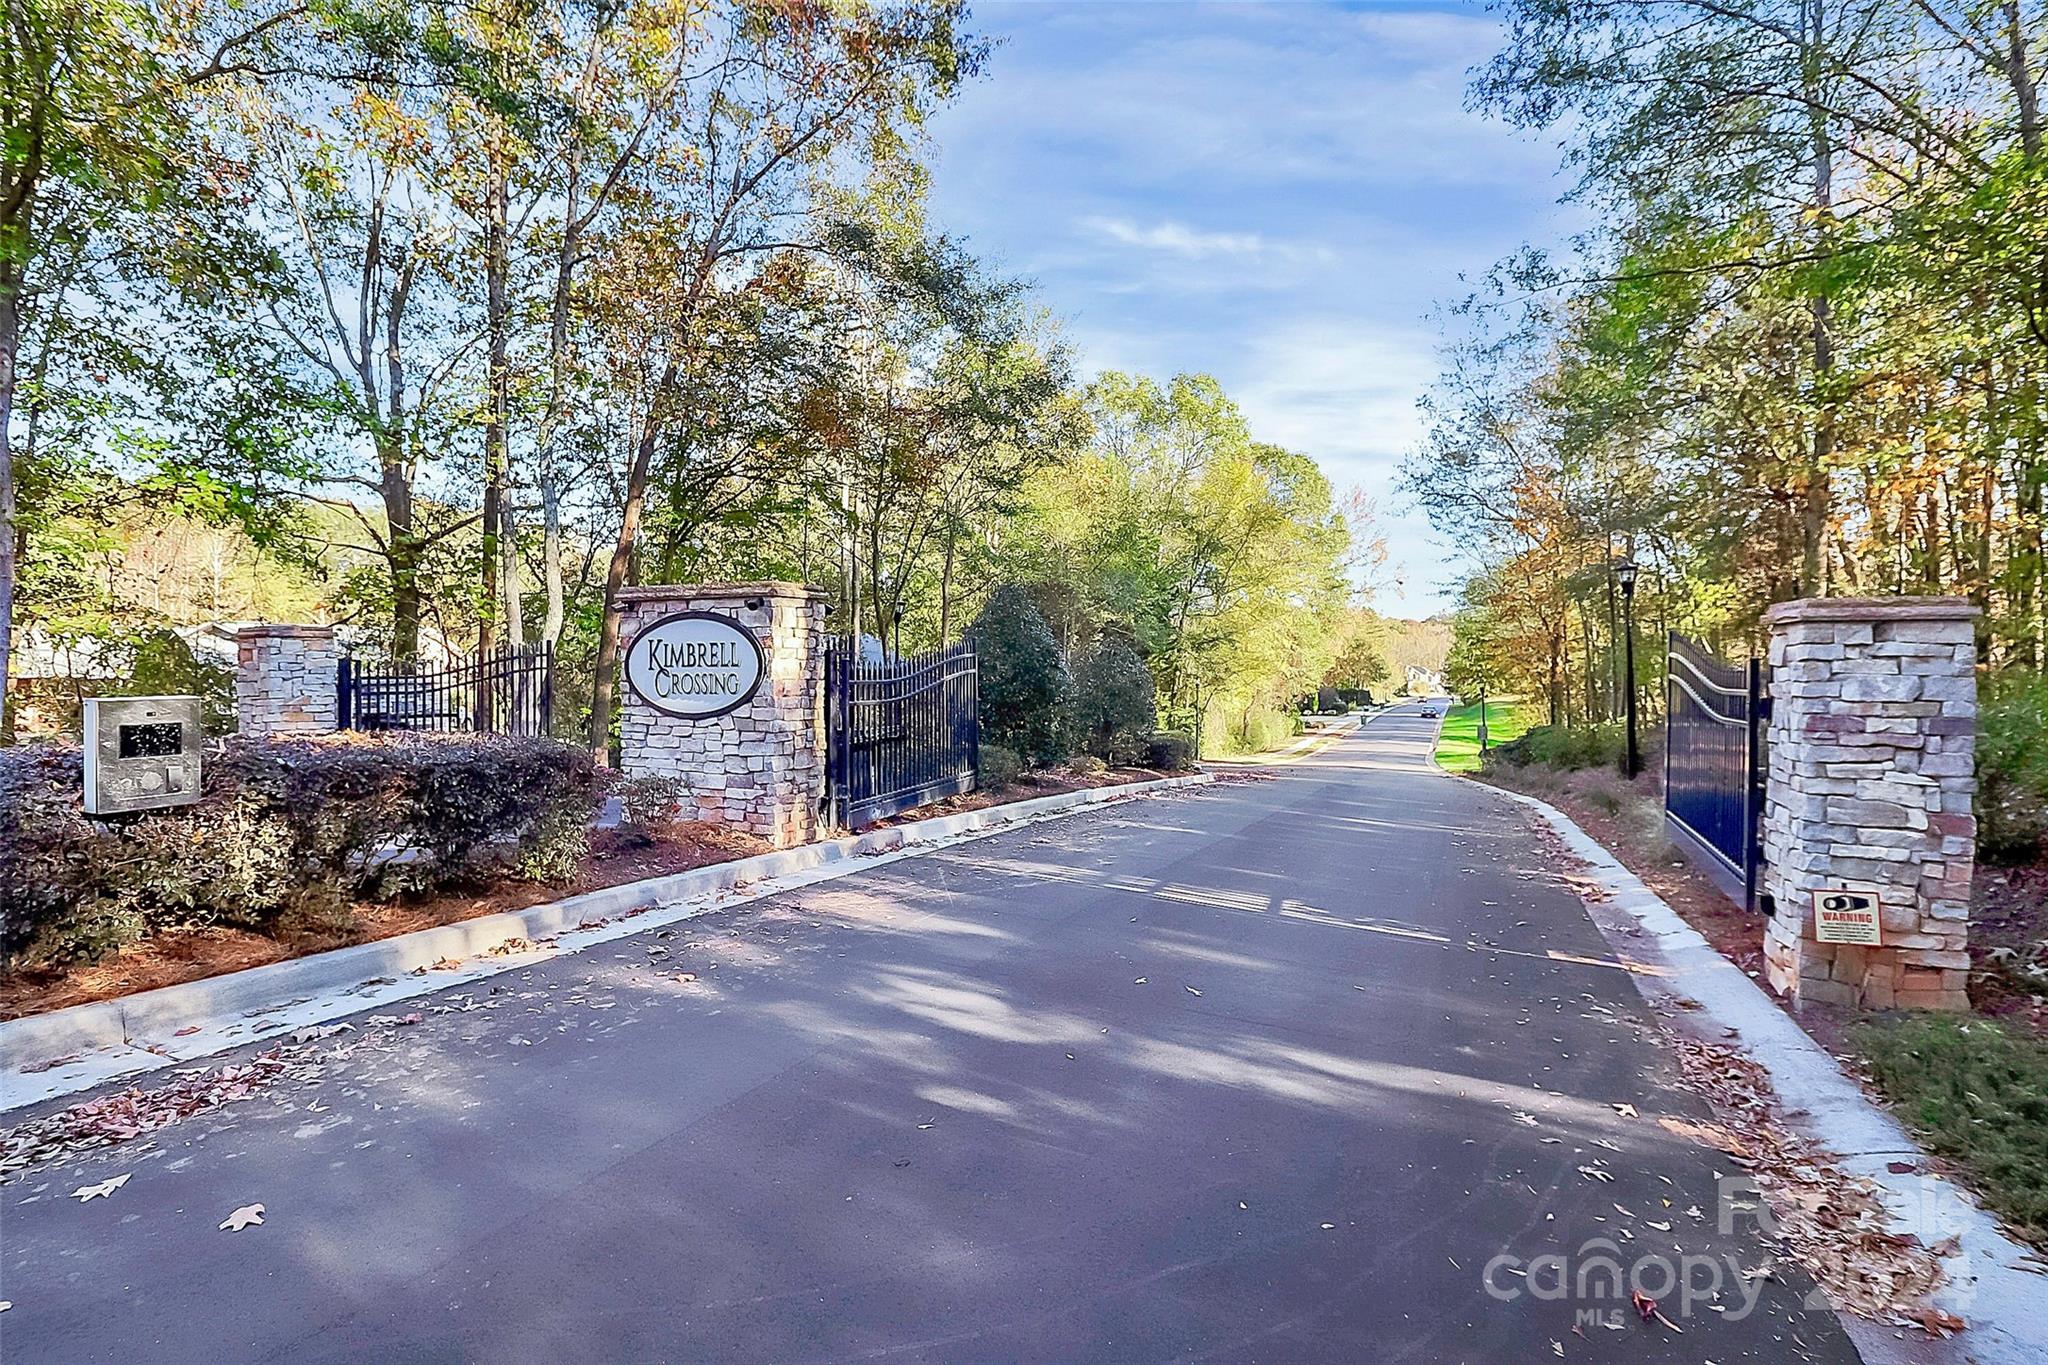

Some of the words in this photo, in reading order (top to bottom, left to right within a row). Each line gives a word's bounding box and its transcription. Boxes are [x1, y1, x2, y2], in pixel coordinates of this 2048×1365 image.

[648, 639, 740, 671] KIMBRELL
[655, 669, 740, 698] CROSSING
[1822, 912, 1873, 923] WARNING
